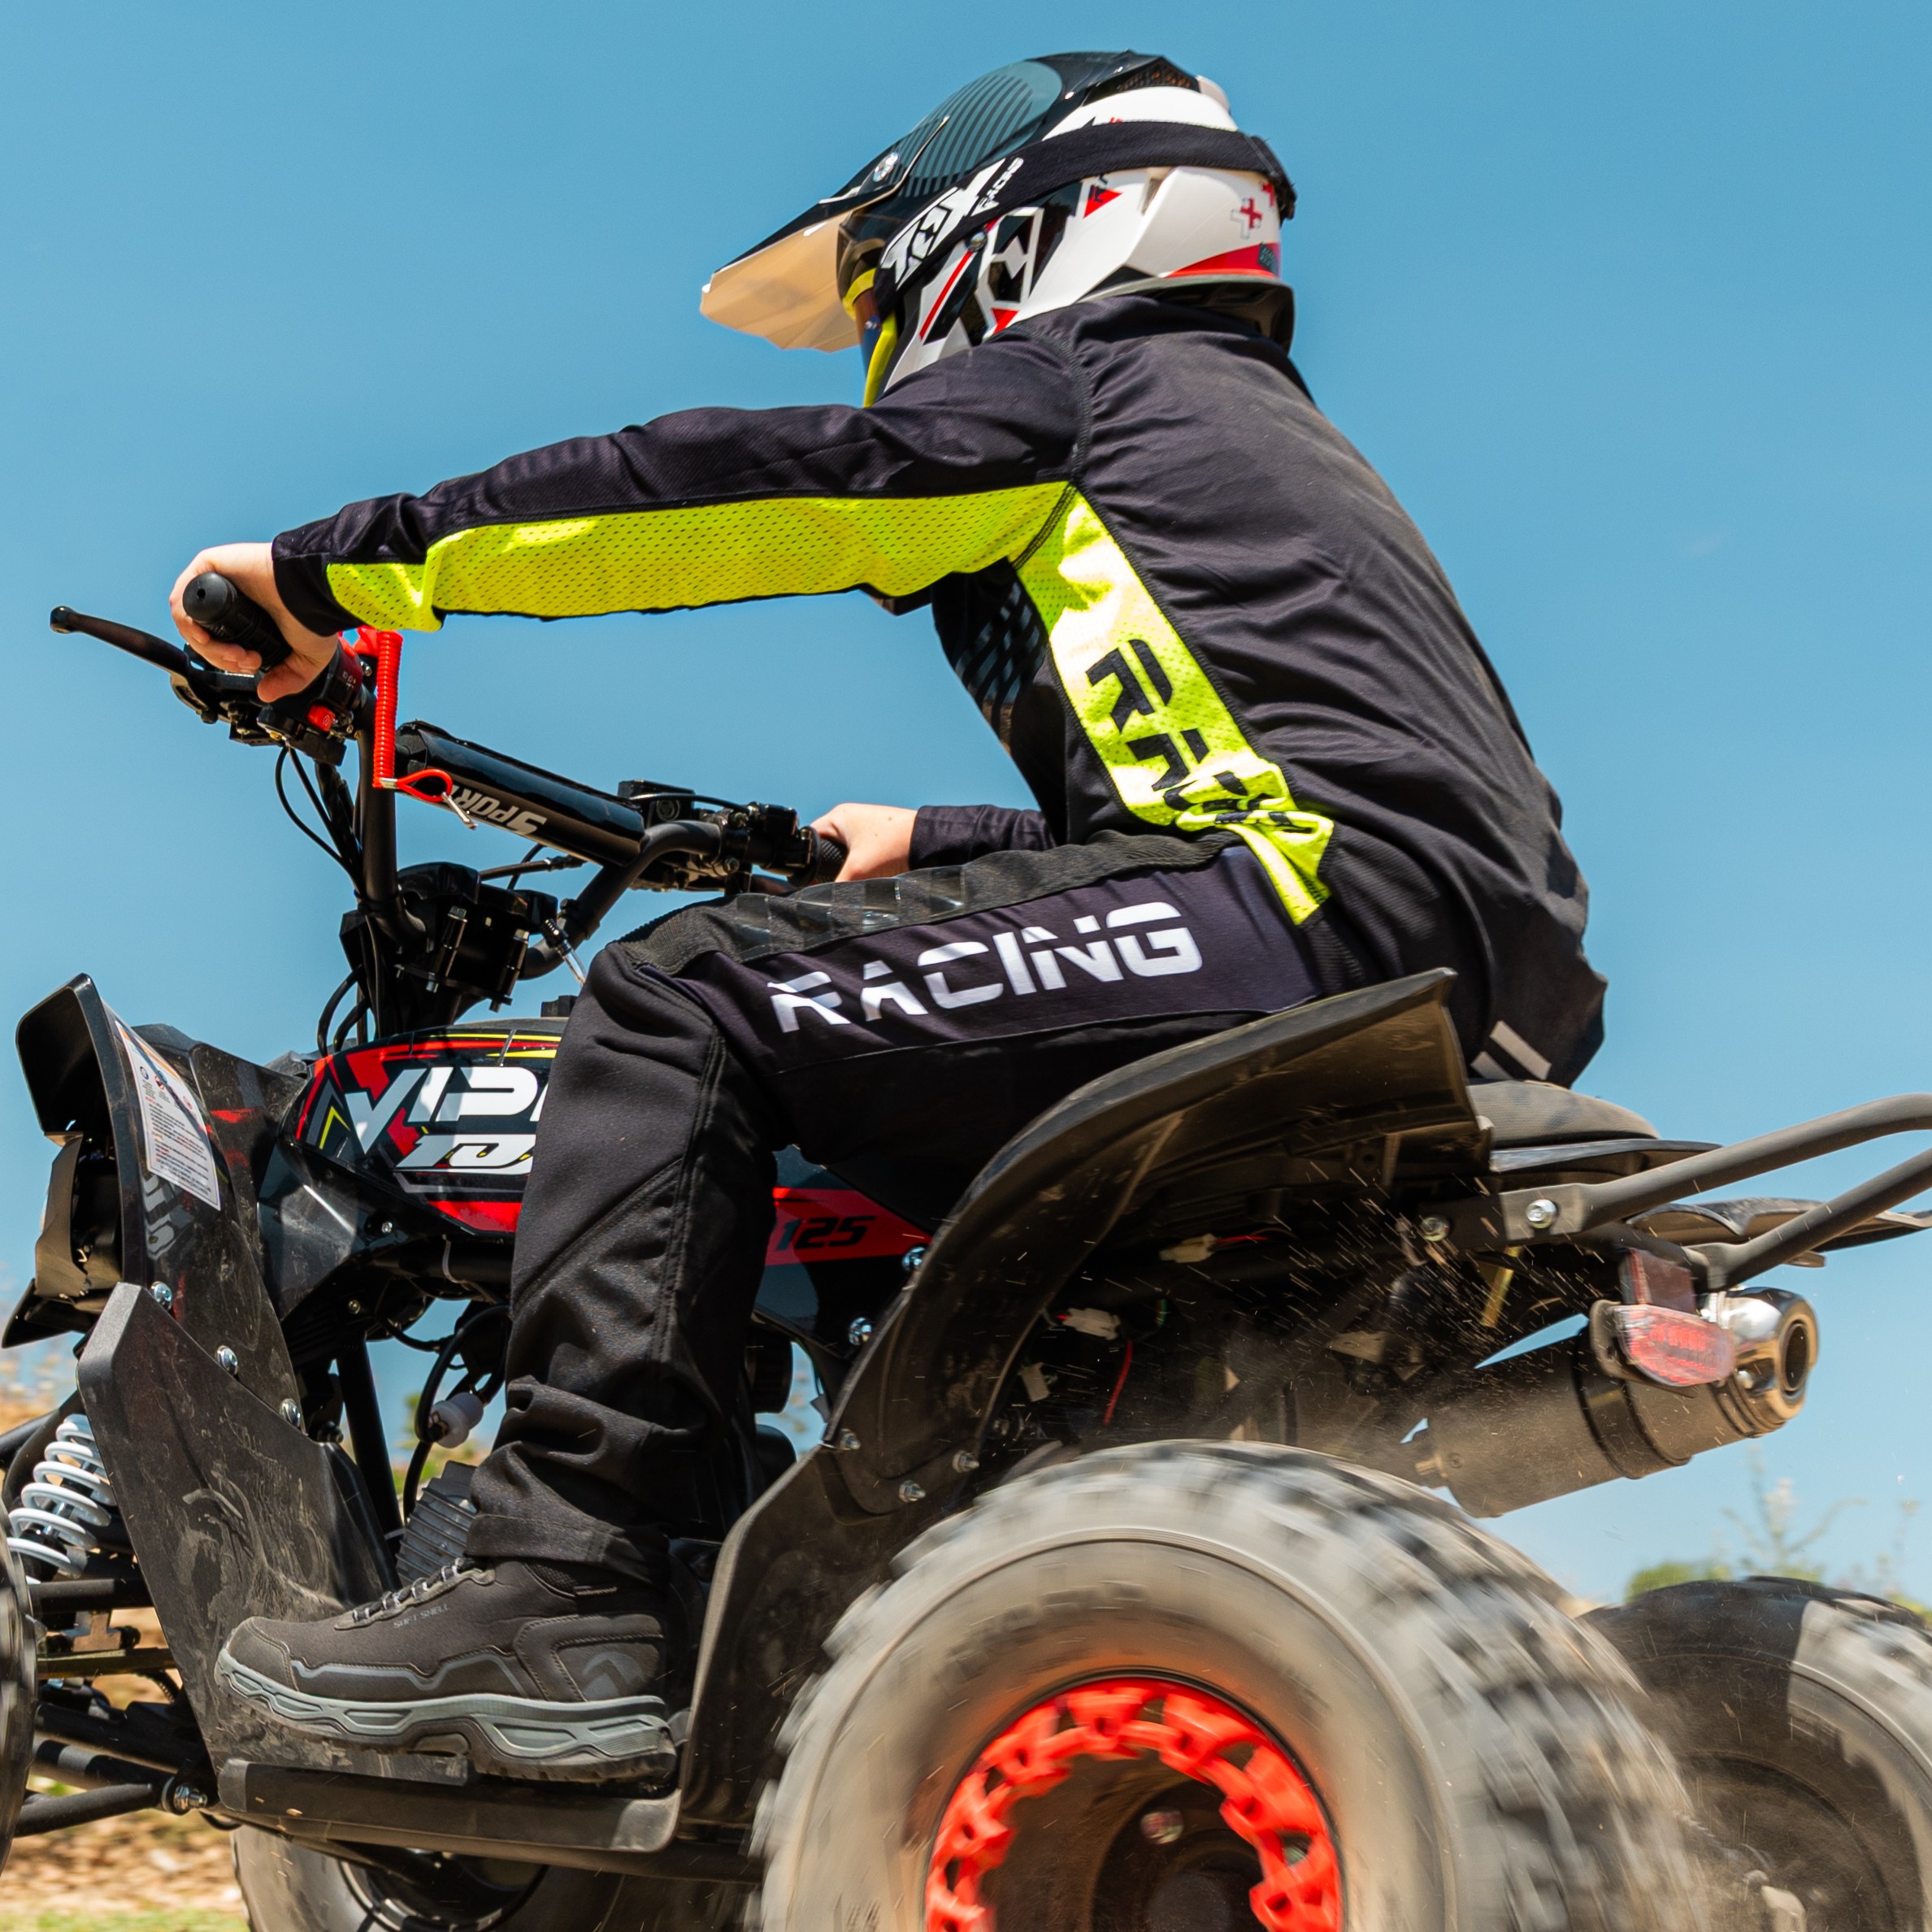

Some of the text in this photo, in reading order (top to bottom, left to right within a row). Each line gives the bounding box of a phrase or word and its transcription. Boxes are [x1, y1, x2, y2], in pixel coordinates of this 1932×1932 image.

[451, 784, 548, 836] SPOR
[766, 901, 1203, 1033] RACING
[775, 1215, 877, 1252] 125
